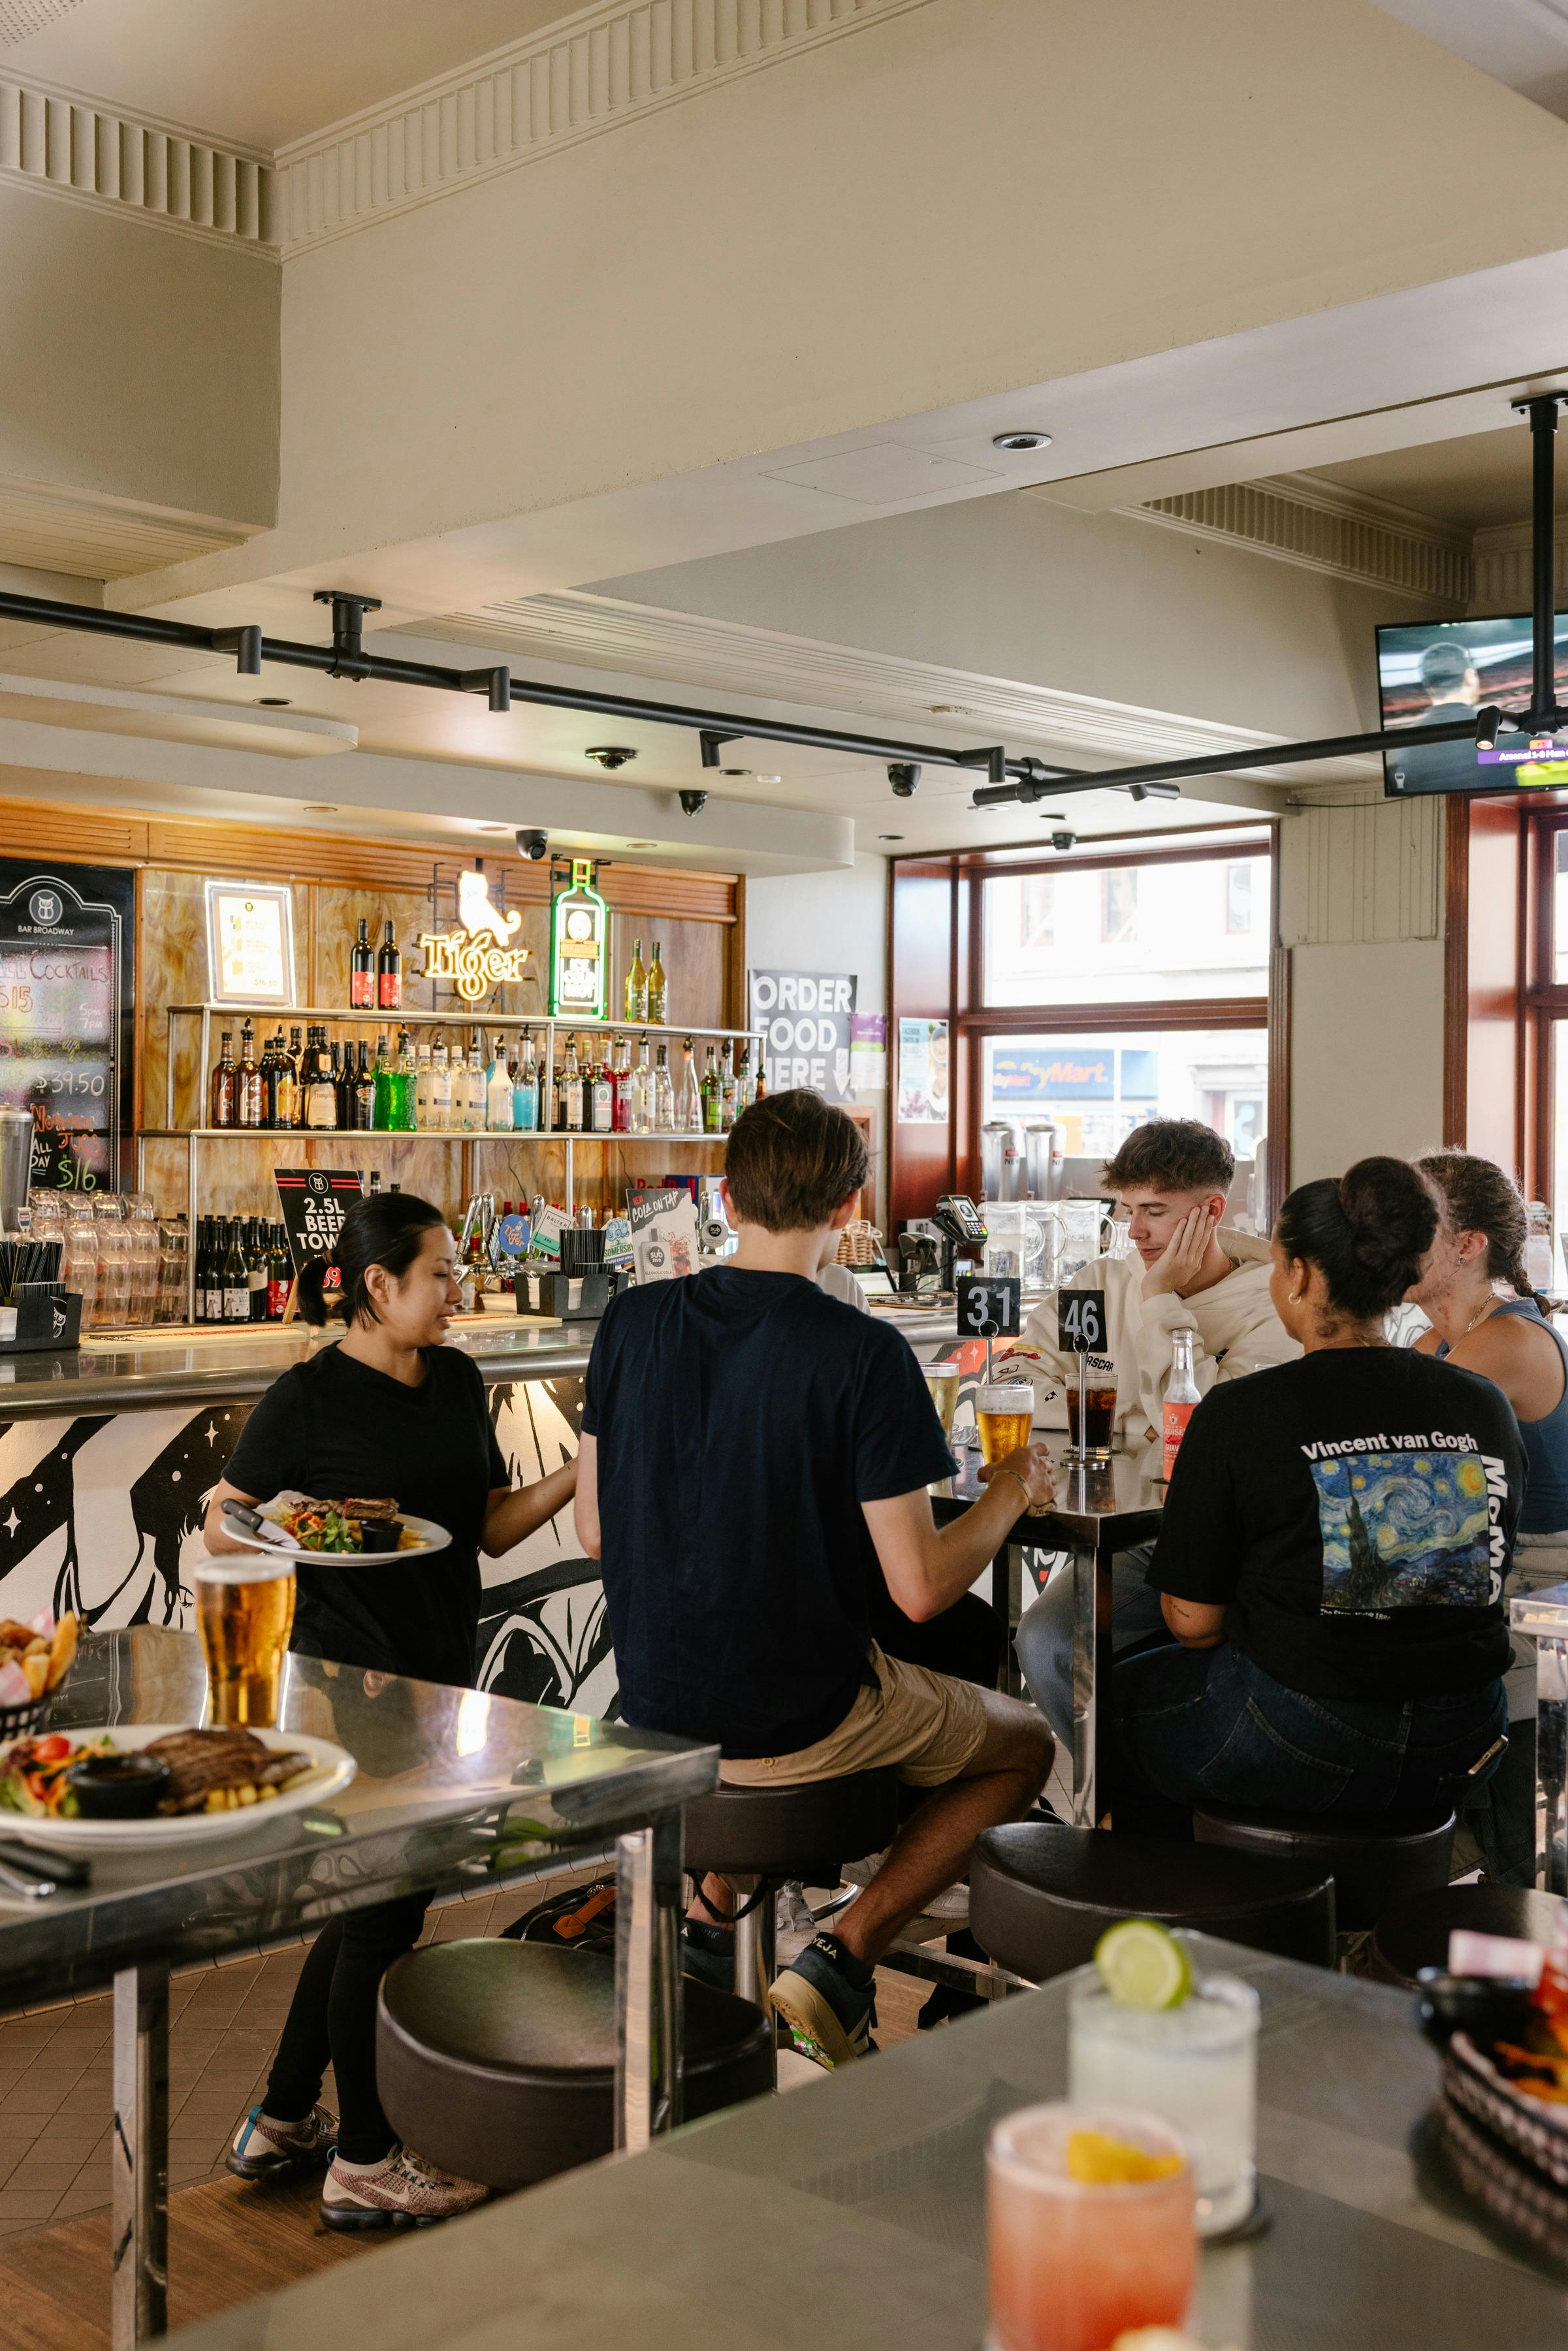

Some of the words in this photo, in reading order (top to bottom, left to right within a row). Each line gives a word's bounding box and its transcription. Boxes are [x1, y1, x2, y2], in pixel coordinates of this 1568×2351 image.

[1499, 751, 1531, 761] Arsenal
[33, 926, 74, 935] BROADWAY
[419, 931, 528, 1002] Tiger
[753, 976, 852, 1012] ORDER
[754, 1017, 838, 1052] FOOD
[35, 1071, 104, 1096] $39.50
[752, 1057, 826, 1091] HERE
[33, 1140, 52, 1153] ALL
[56, 1154, 96, 1192] $16
[304, 1198, 345, 1214] 2.5L
[632, 1202, 654, 1223] COLA
[653, 1199, 664, 1211] ON
[662, 1191, 679, 1208] TAP
[546, 1215, 568, 1228] BALTER
[296, 1233, 340, 1249] TOW
[604, 1243, 633, 1258] SOMERSBY
[650, 1249, 663, 1258] sub
[967, 1286, 1011, 1327] 31
[1064, 1300, 1098, 1343] 46
[1087, 1355, 1114, 1372] ASCAR
[1300, 1433, 1390, 1460] Vincent
[1390, 1434, 1429, 1449] van
[1430, 1431, 1479, 1452] Gogh
[1480, 1455, 1508, 1605] MoMA
